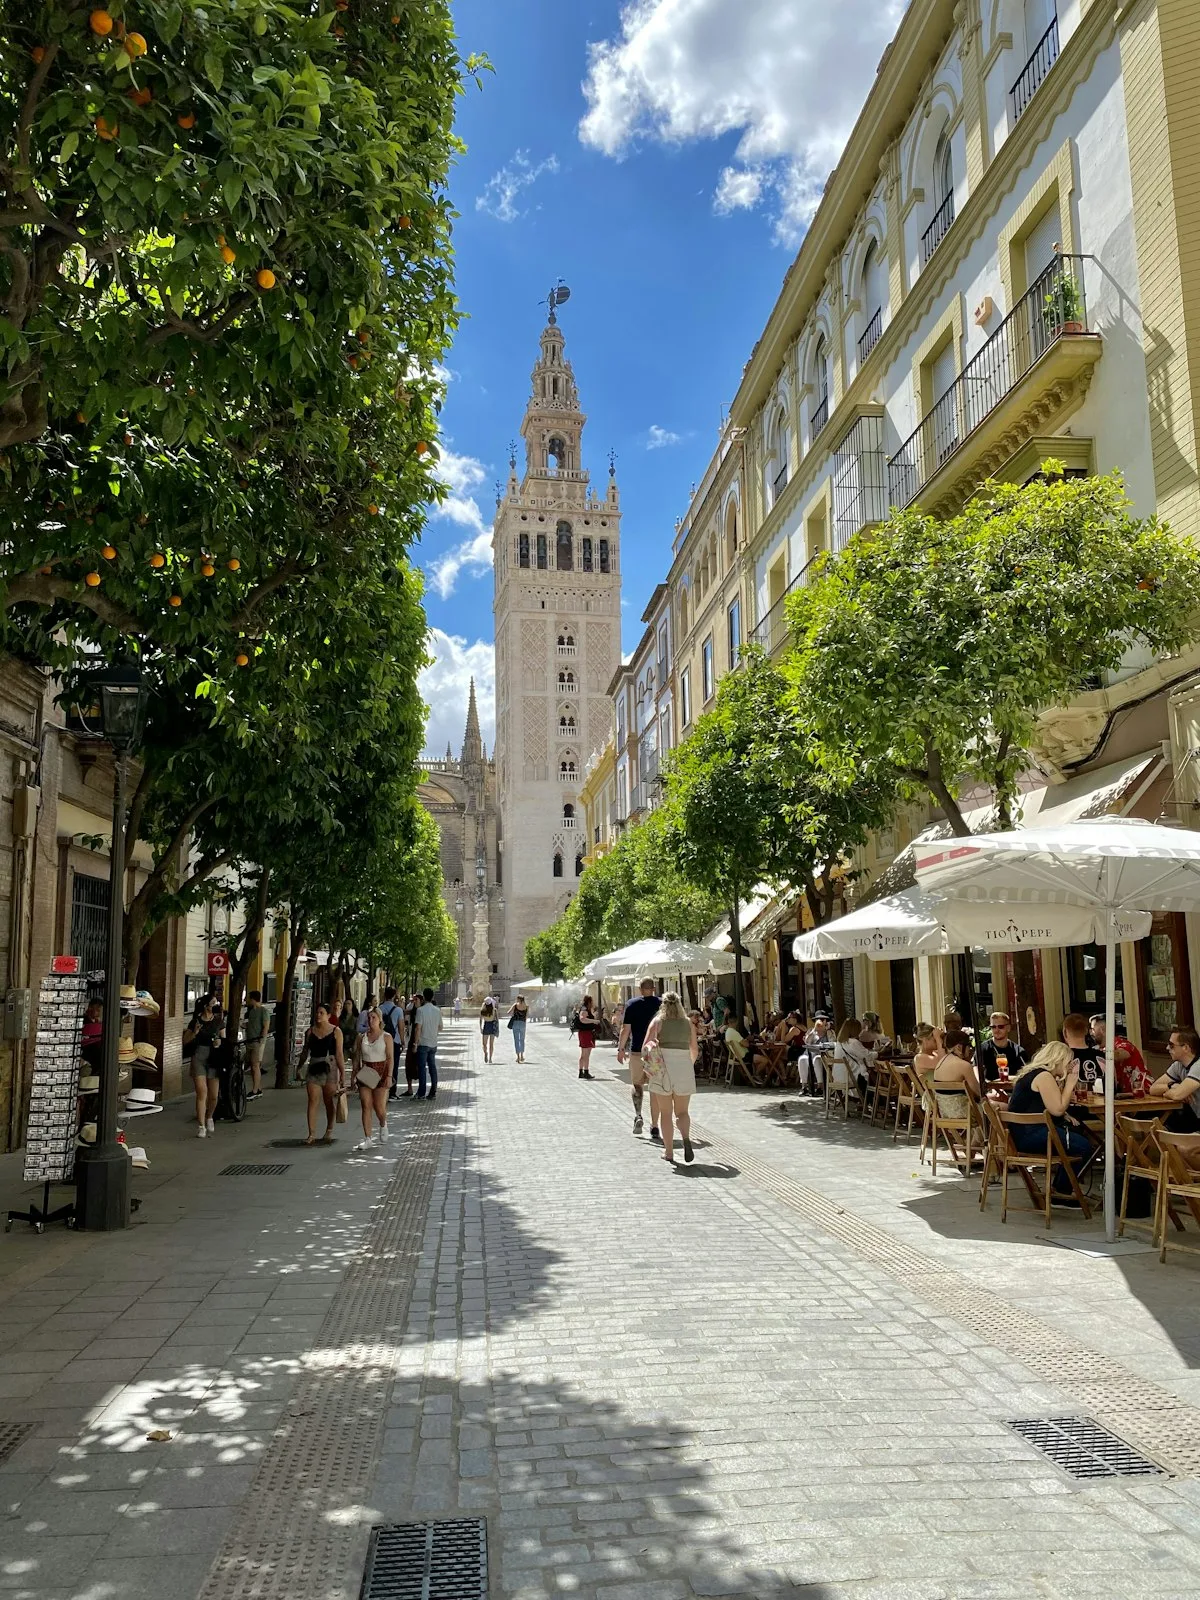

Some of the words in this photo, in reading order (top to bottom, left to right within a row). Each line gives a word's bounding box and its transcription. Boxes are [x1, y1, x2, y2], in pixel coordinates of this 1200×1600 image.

[985, 930, 1007, 939] TIO
[1021, 929, 1052, 938] PEPE
[853, 938, 872, 947] TIO
[885, 936, 908, 945] PEPE
